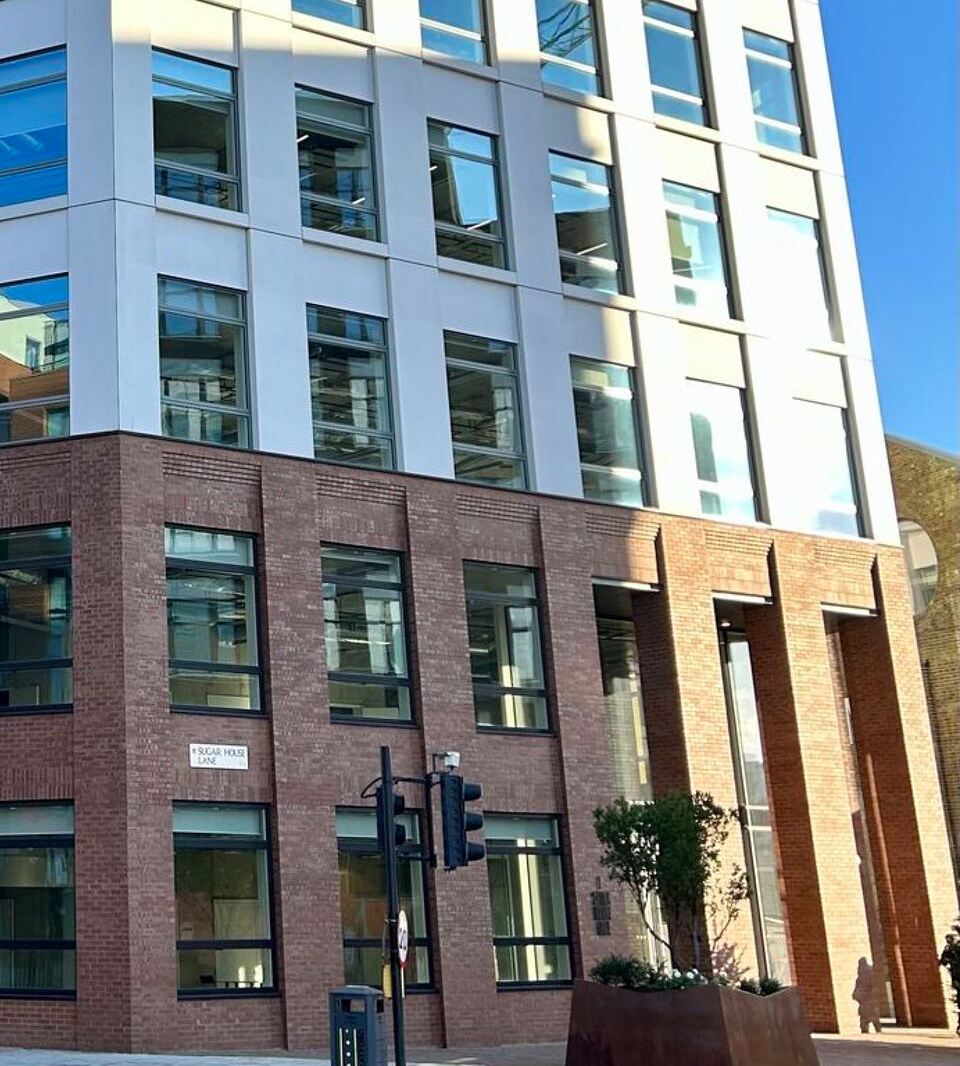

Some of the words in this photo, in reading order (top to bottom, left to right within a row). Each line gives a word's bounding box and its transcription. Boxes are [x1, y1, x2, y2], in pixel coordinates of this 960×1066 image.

[197, 747, 222, 756] SUGAR
[223, 748, 245, 757] HOUSE
[198, 757, 217, 766] LANE
